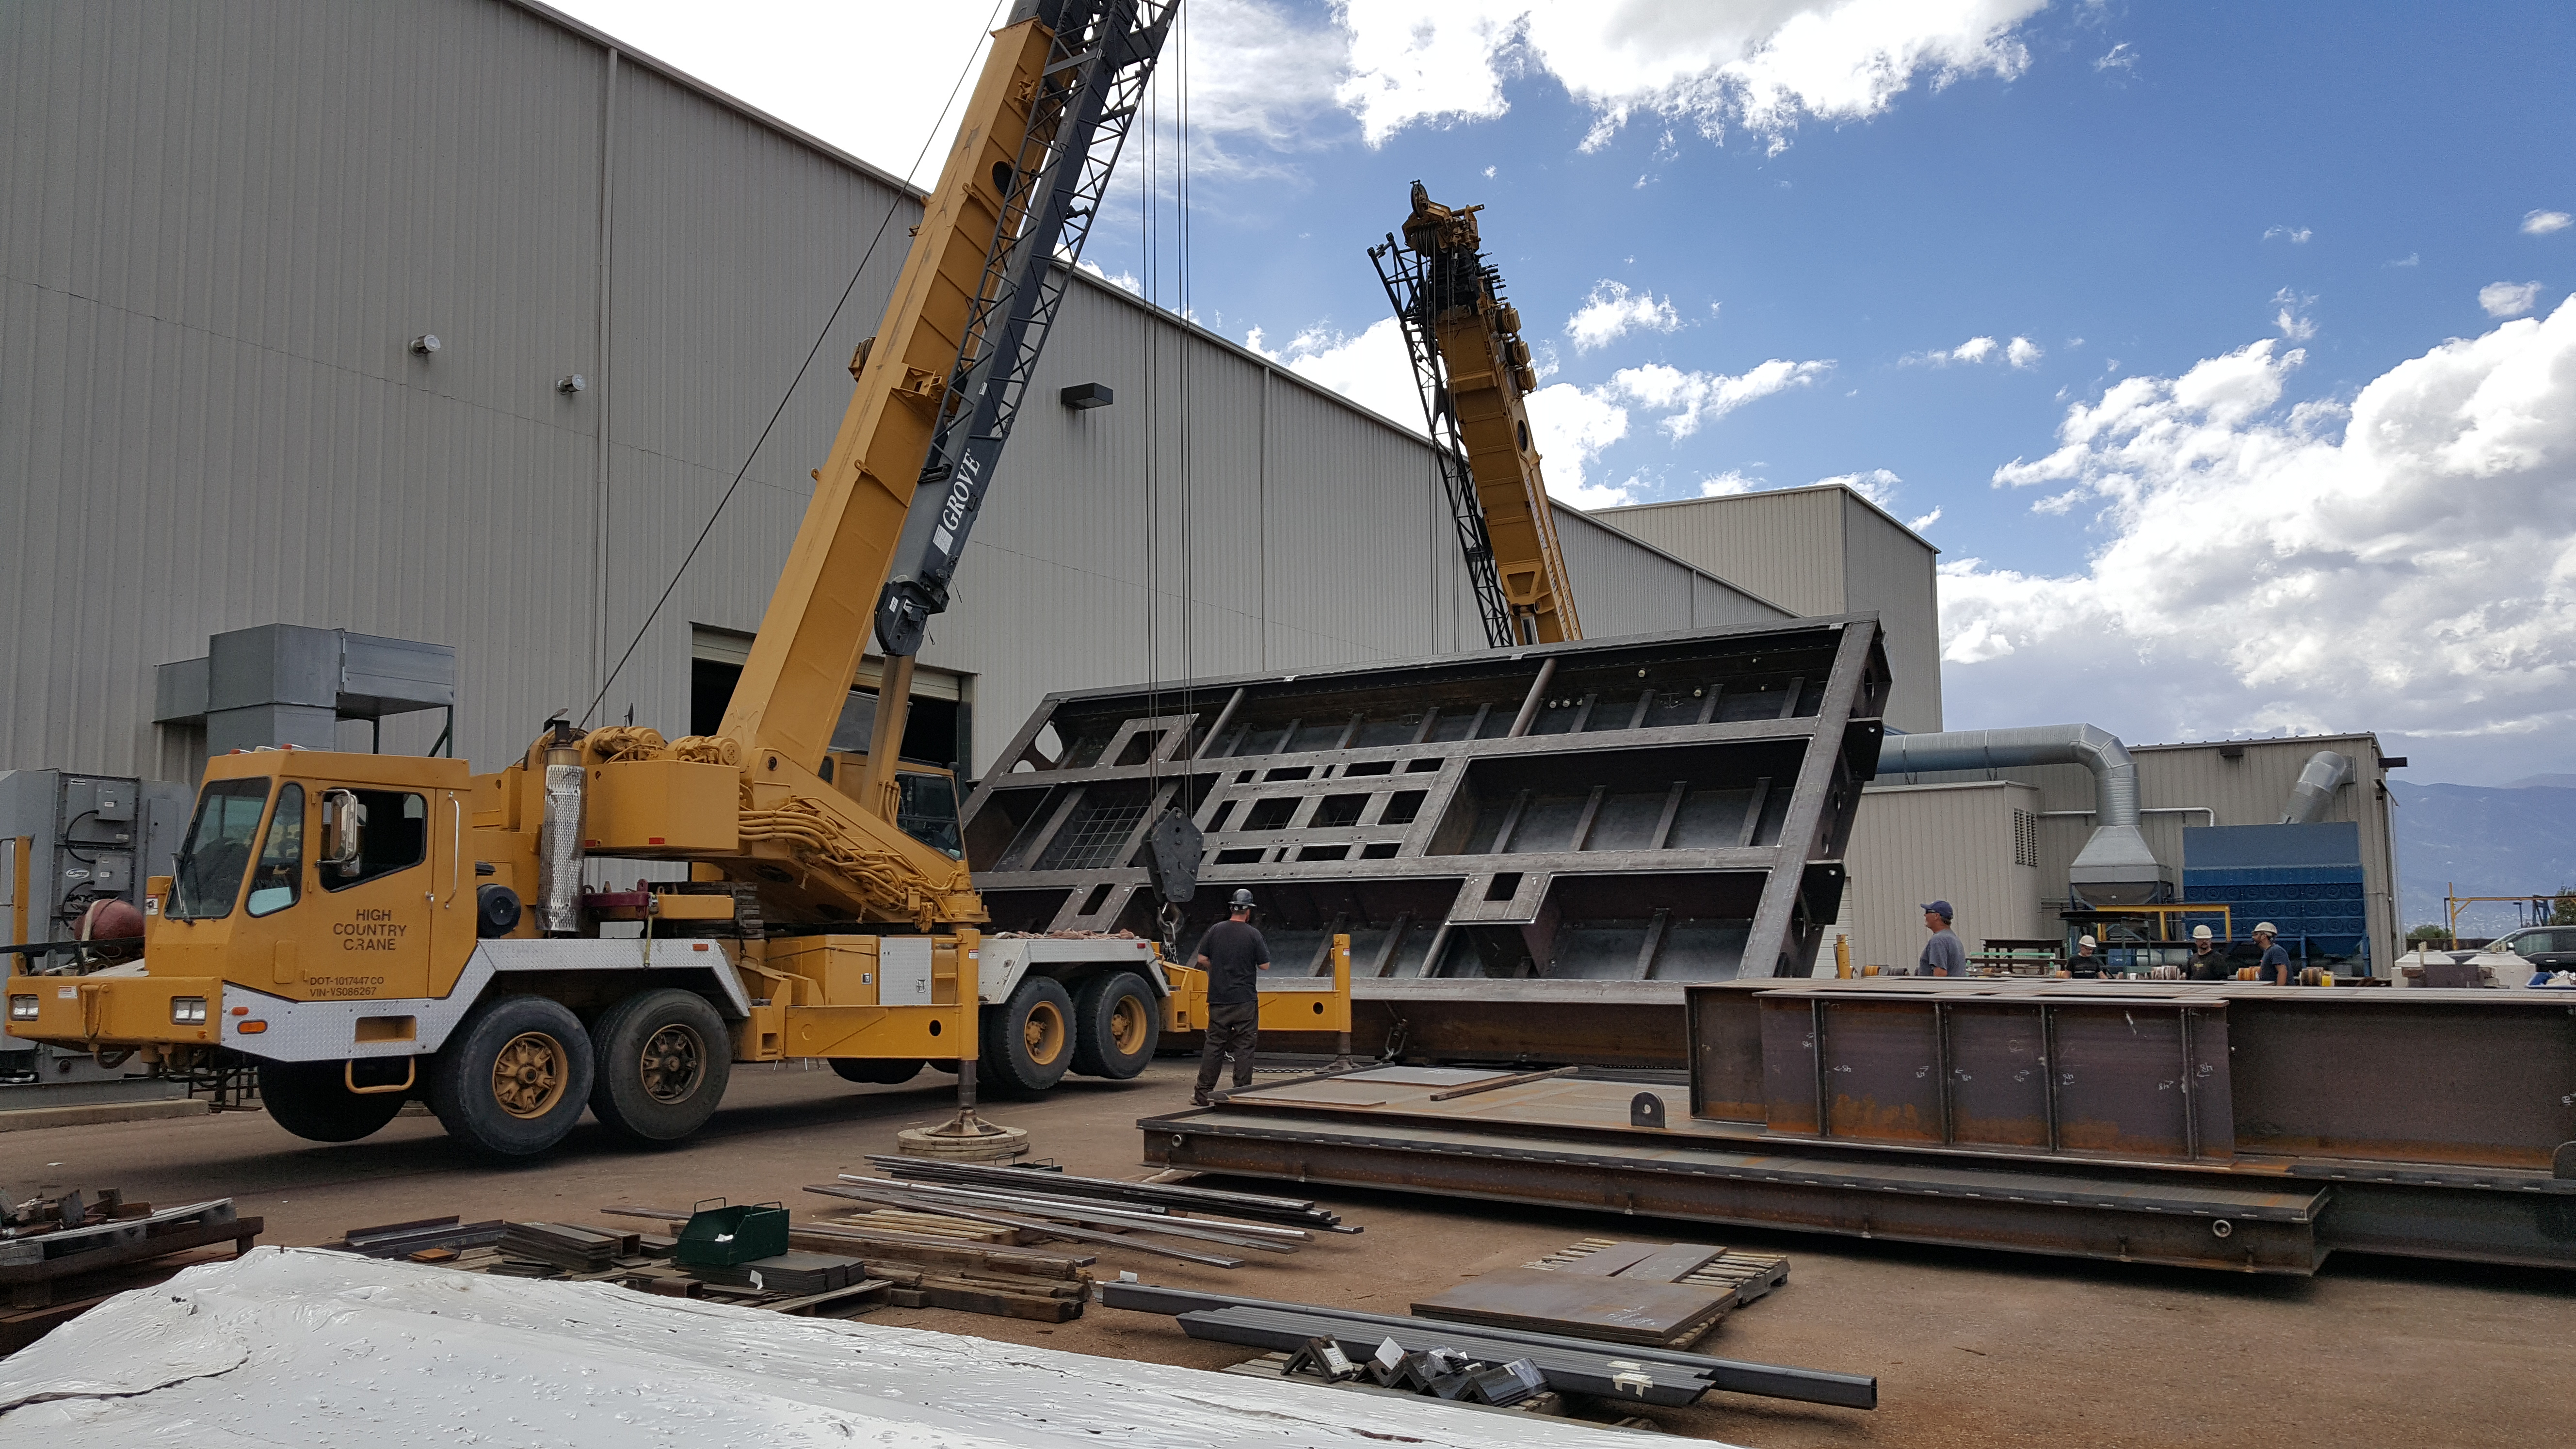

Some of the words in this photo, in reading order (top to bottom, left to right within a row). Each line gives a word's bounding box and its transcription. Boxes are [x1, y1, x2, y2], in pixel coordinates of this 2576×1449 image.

[943, 452, 980, 531] GROVE
[356, 909, 391, 921] HIGH
[333, 922, 407, 936] COUNTRY
[343, 938, 396, 950] CRANE
[2200, 1062, 2213, 1072] 48
